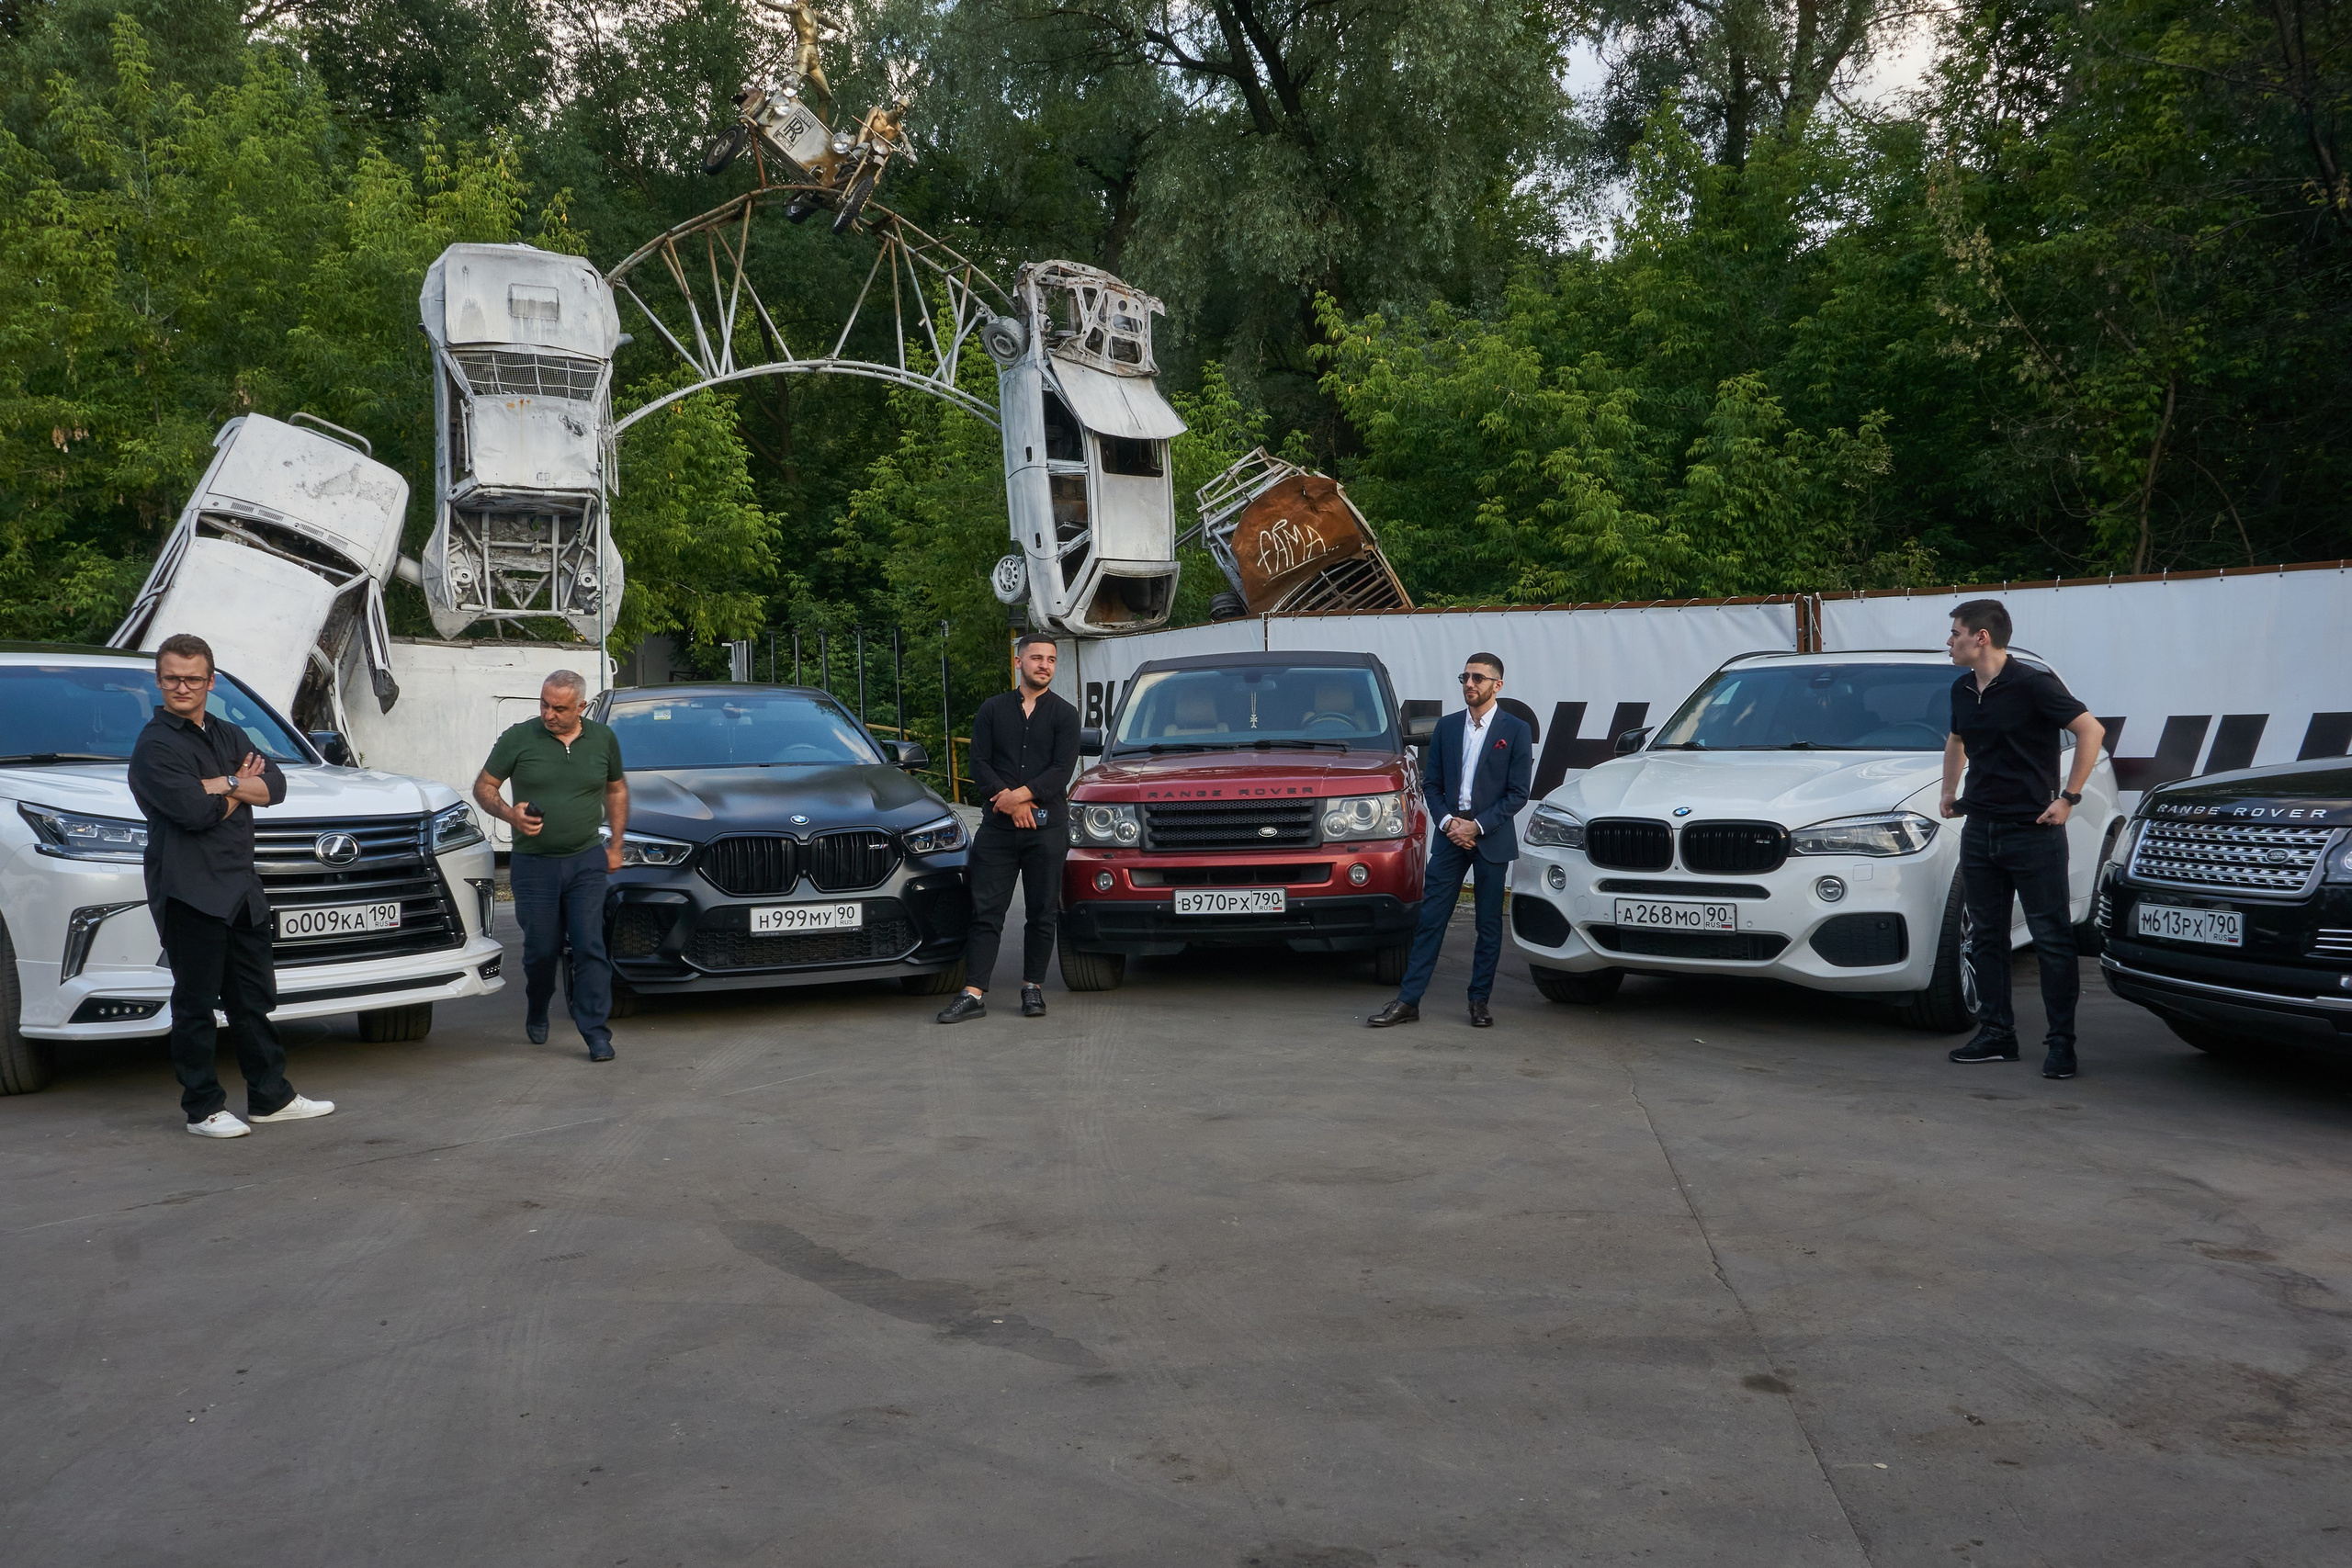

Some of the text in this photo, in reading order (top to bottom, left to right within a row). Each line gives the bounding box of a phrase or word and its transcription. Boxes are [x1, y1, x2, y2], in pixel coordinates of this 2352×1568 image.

[1148, 786, 1314, 799] RANGE ROVER
[2156, 804, 2328, 819] RANGE ROVER
[1252, 892, 1280, 906] 790
[368, 905, 396, 921] 190
[837, 906, 855, 919] 90
[1706, 907, 1727, 922] 90
[2207, 913, 2236, 934] 790
